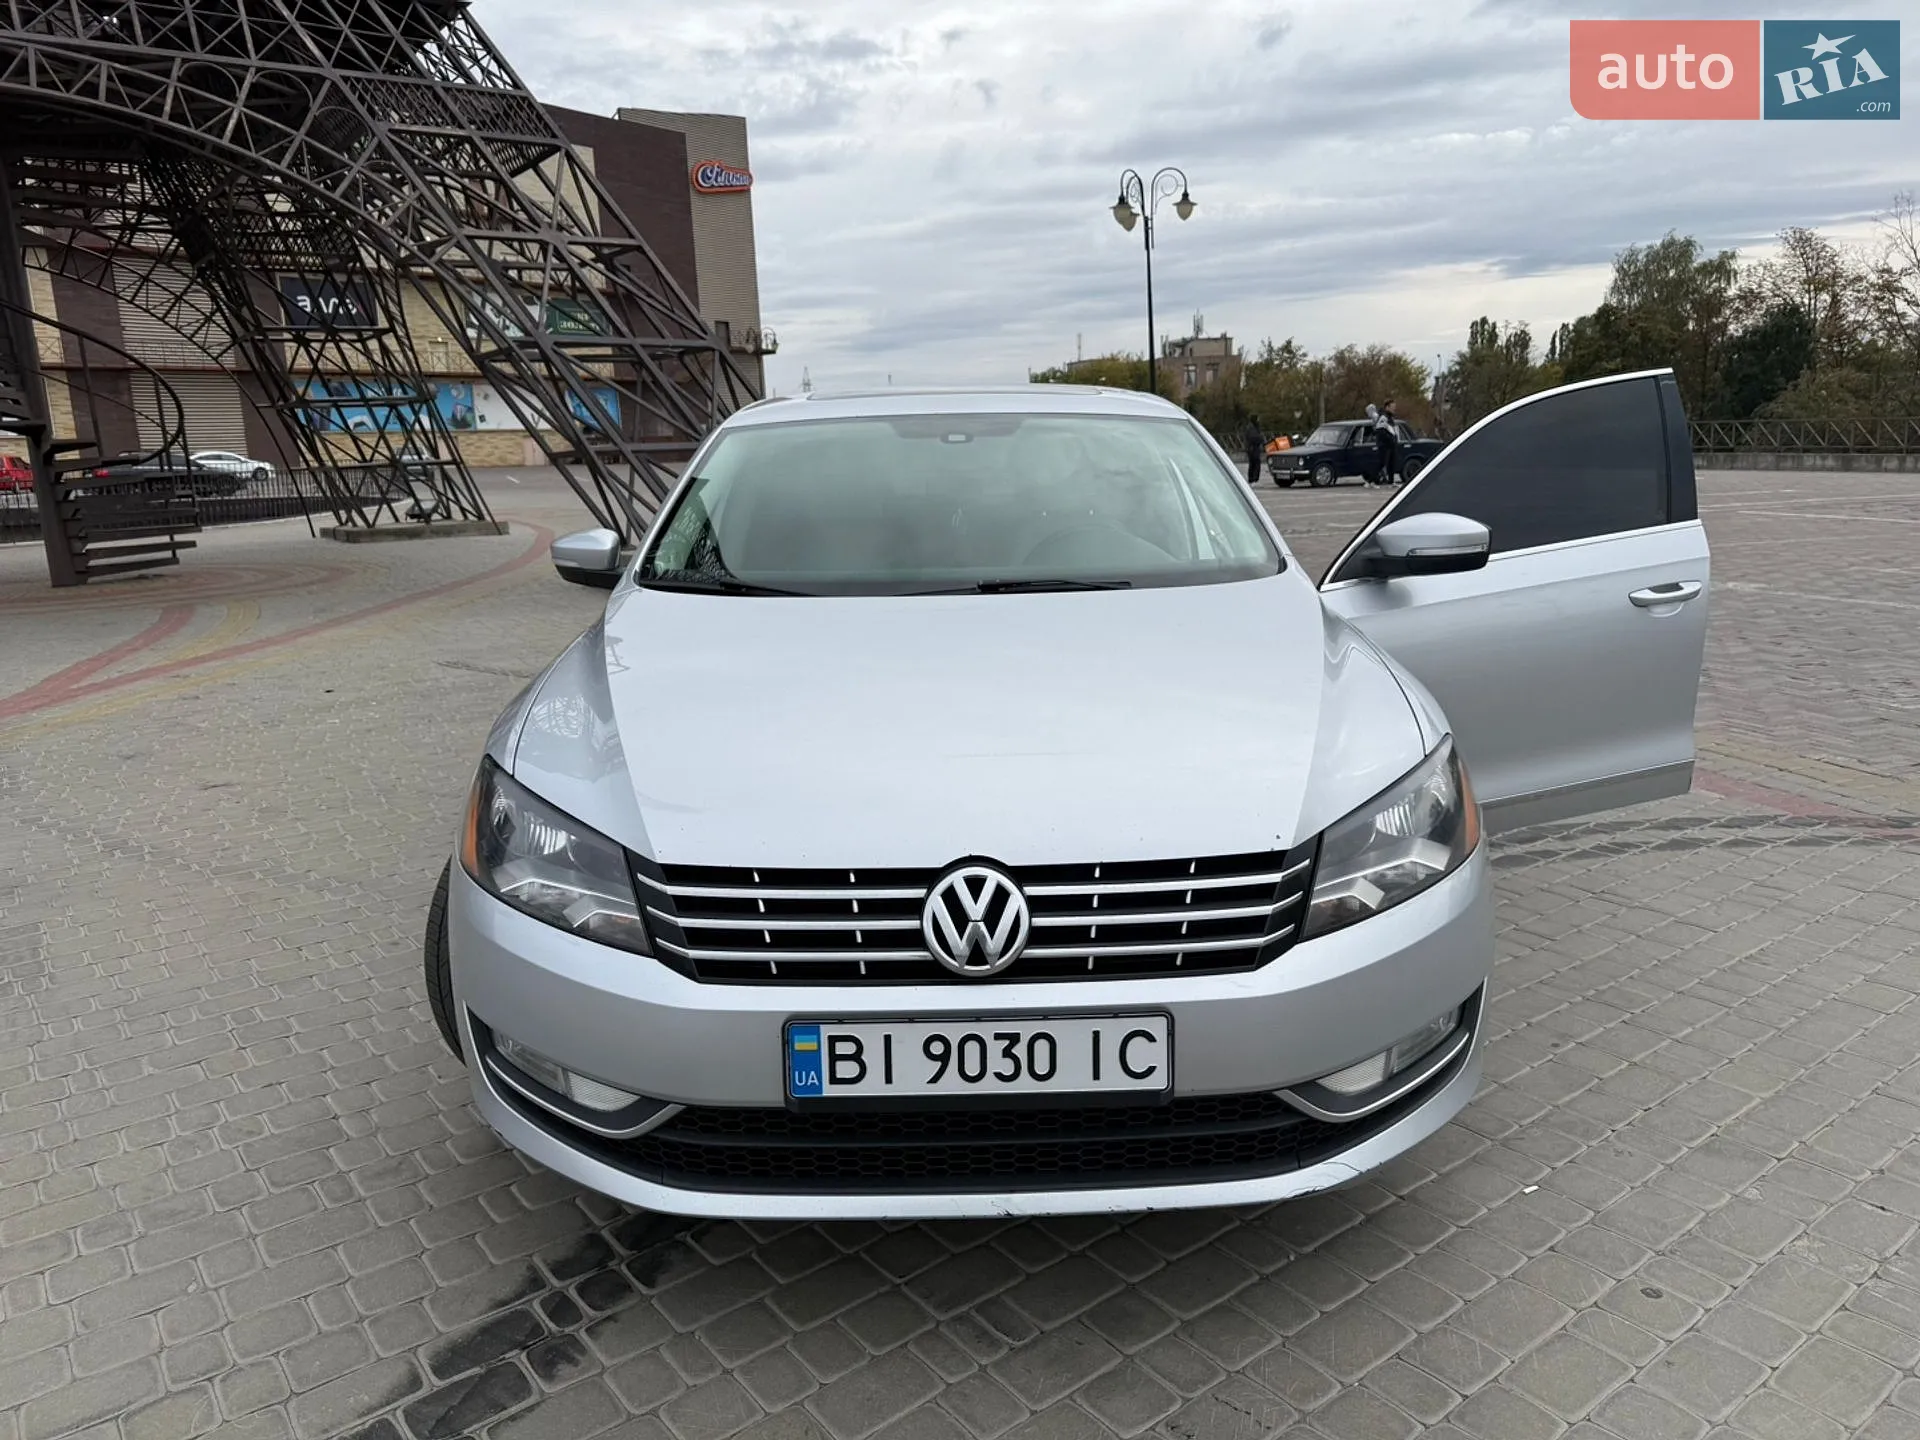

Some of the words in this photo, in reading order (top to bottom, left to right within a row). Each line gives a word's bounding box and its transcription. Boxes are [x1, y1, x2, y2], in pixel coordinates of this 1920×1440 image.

[827, 1033, 893, 1086] BI
[922, 1031, 1057, 1084] 9030
[1091, 1029, 1158, 1081] IC
[794, 1070, 820, 1087] UA
